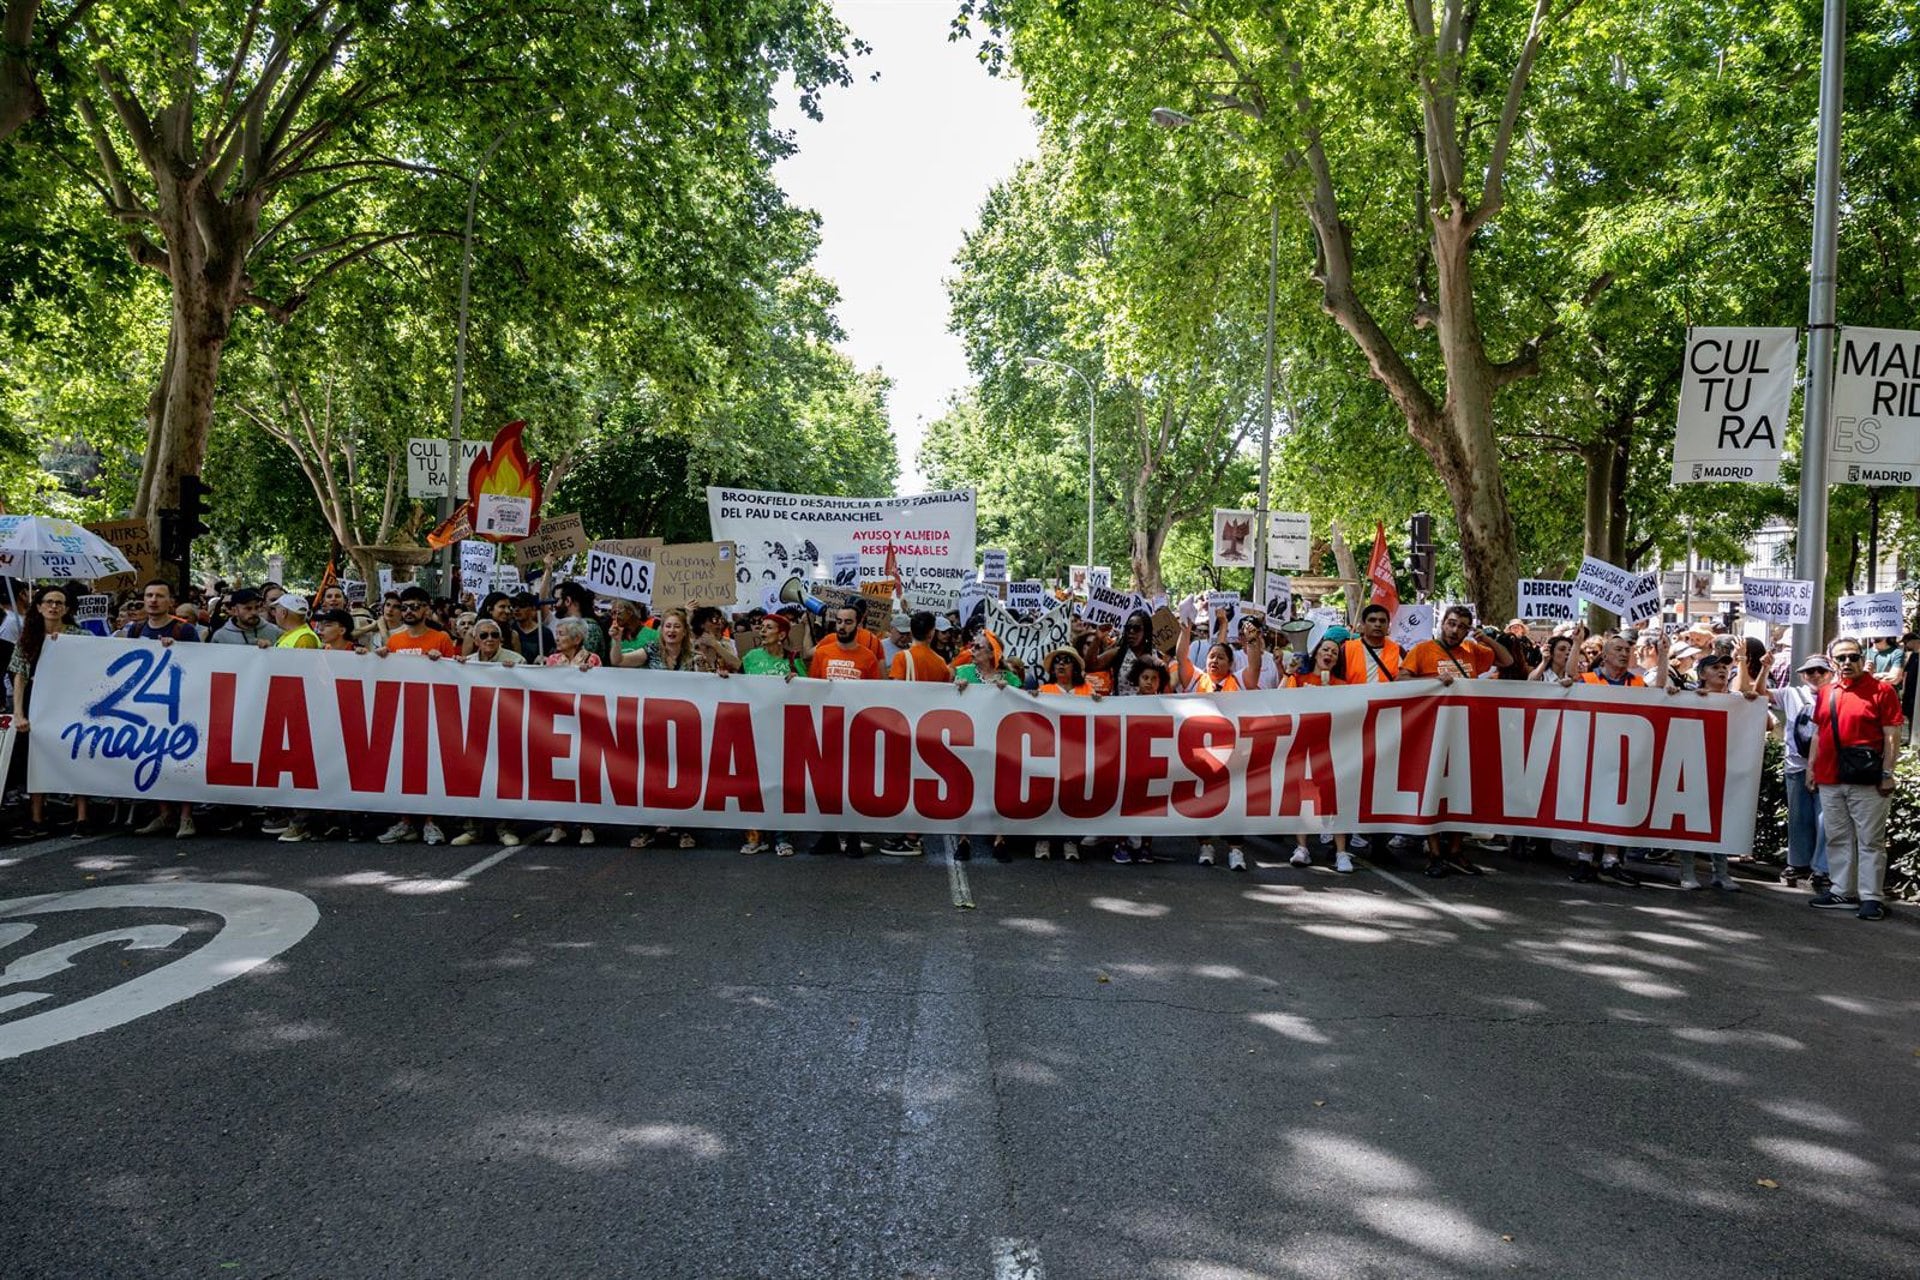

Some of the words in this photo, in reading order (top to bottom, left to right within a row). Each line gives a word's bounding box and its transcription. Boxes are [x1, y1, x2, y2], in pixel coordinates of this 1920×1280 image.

[1690, 340, 1770, 374] CUL
[1699, 378, 1752, 412] TU
[1718, 415, 1776, 449] RA
[1834, 416, 1882, 454] ES
[410, 442, 442, 457] CUL
[416, 457, 438, 471] TU
[1704, 467, 1753, 478] MADRID
[428, 472, 448, 486] RA
[1861, 470, 1912, 483] MADRID
[721, 491, 796, 507] BROOKFIELD
[800, 498, 870, 509] DESAHUCIA
[874, 500, 882, 508] A
[886, 498, 909, 508] 859
[912, 491, 970, 506] FAMILIAS
[720, 508, 742, 518] DEL
[746, 508, 770, 520] PAU
[774, 510, 788, 520] DE
[790, 511, 883, 522] CARABANCHEL
[852, 530, 892, 541] AYUSO
[894, 530, 901, 540] Y
[904, 530, 950, 540] ALMEIDA
[524, 536, 574, 559] HENARES
[862, 545, 949, 556] RESPONSABLES
[1580, 562, 1625, 589] DESAHUCIAR,
[663, 585, 676, 596] NO
[681, 581, 731, 601] TURISTAS
[1010, 584, 1041, 594] DERECHO
[1574, 579, 1580, 590] A
[1580, 580, 1607, 600] BANCOS
[1744, 583, 1798, 600] DESAHUCIAR,
[1011, 598, 1016, 607] A
[1017, 598, 1041, 608] TECHO.
[1094, 588, 1130, 610] DERECHO
[1746, 600, 1750, 610] A
[1750, 600, 1783, 616] BANCOS
[1087, 607, 1094, 620] A
[1096, 609, 1122, 628] TECHO.
[1525, 603, 1533, 616] A
[1536, 603, 1574, 620] TECHO.
[1630, 606, 1640, 622] A
[1638, 597, 1660, 618] TECH
[88, 647, 182, 728] 24
[61, 720, 198, 792] mayo
[205, 672, 318, 790] LA
[335, 679, 765, 813] VIVIENDA
[783, 704, 975, 821] NOS
[994, 711, 1338, 820] CUESTA
[1371, 704, 1472, 817] LA
[1498, 707, 1714, 834] VIDA
